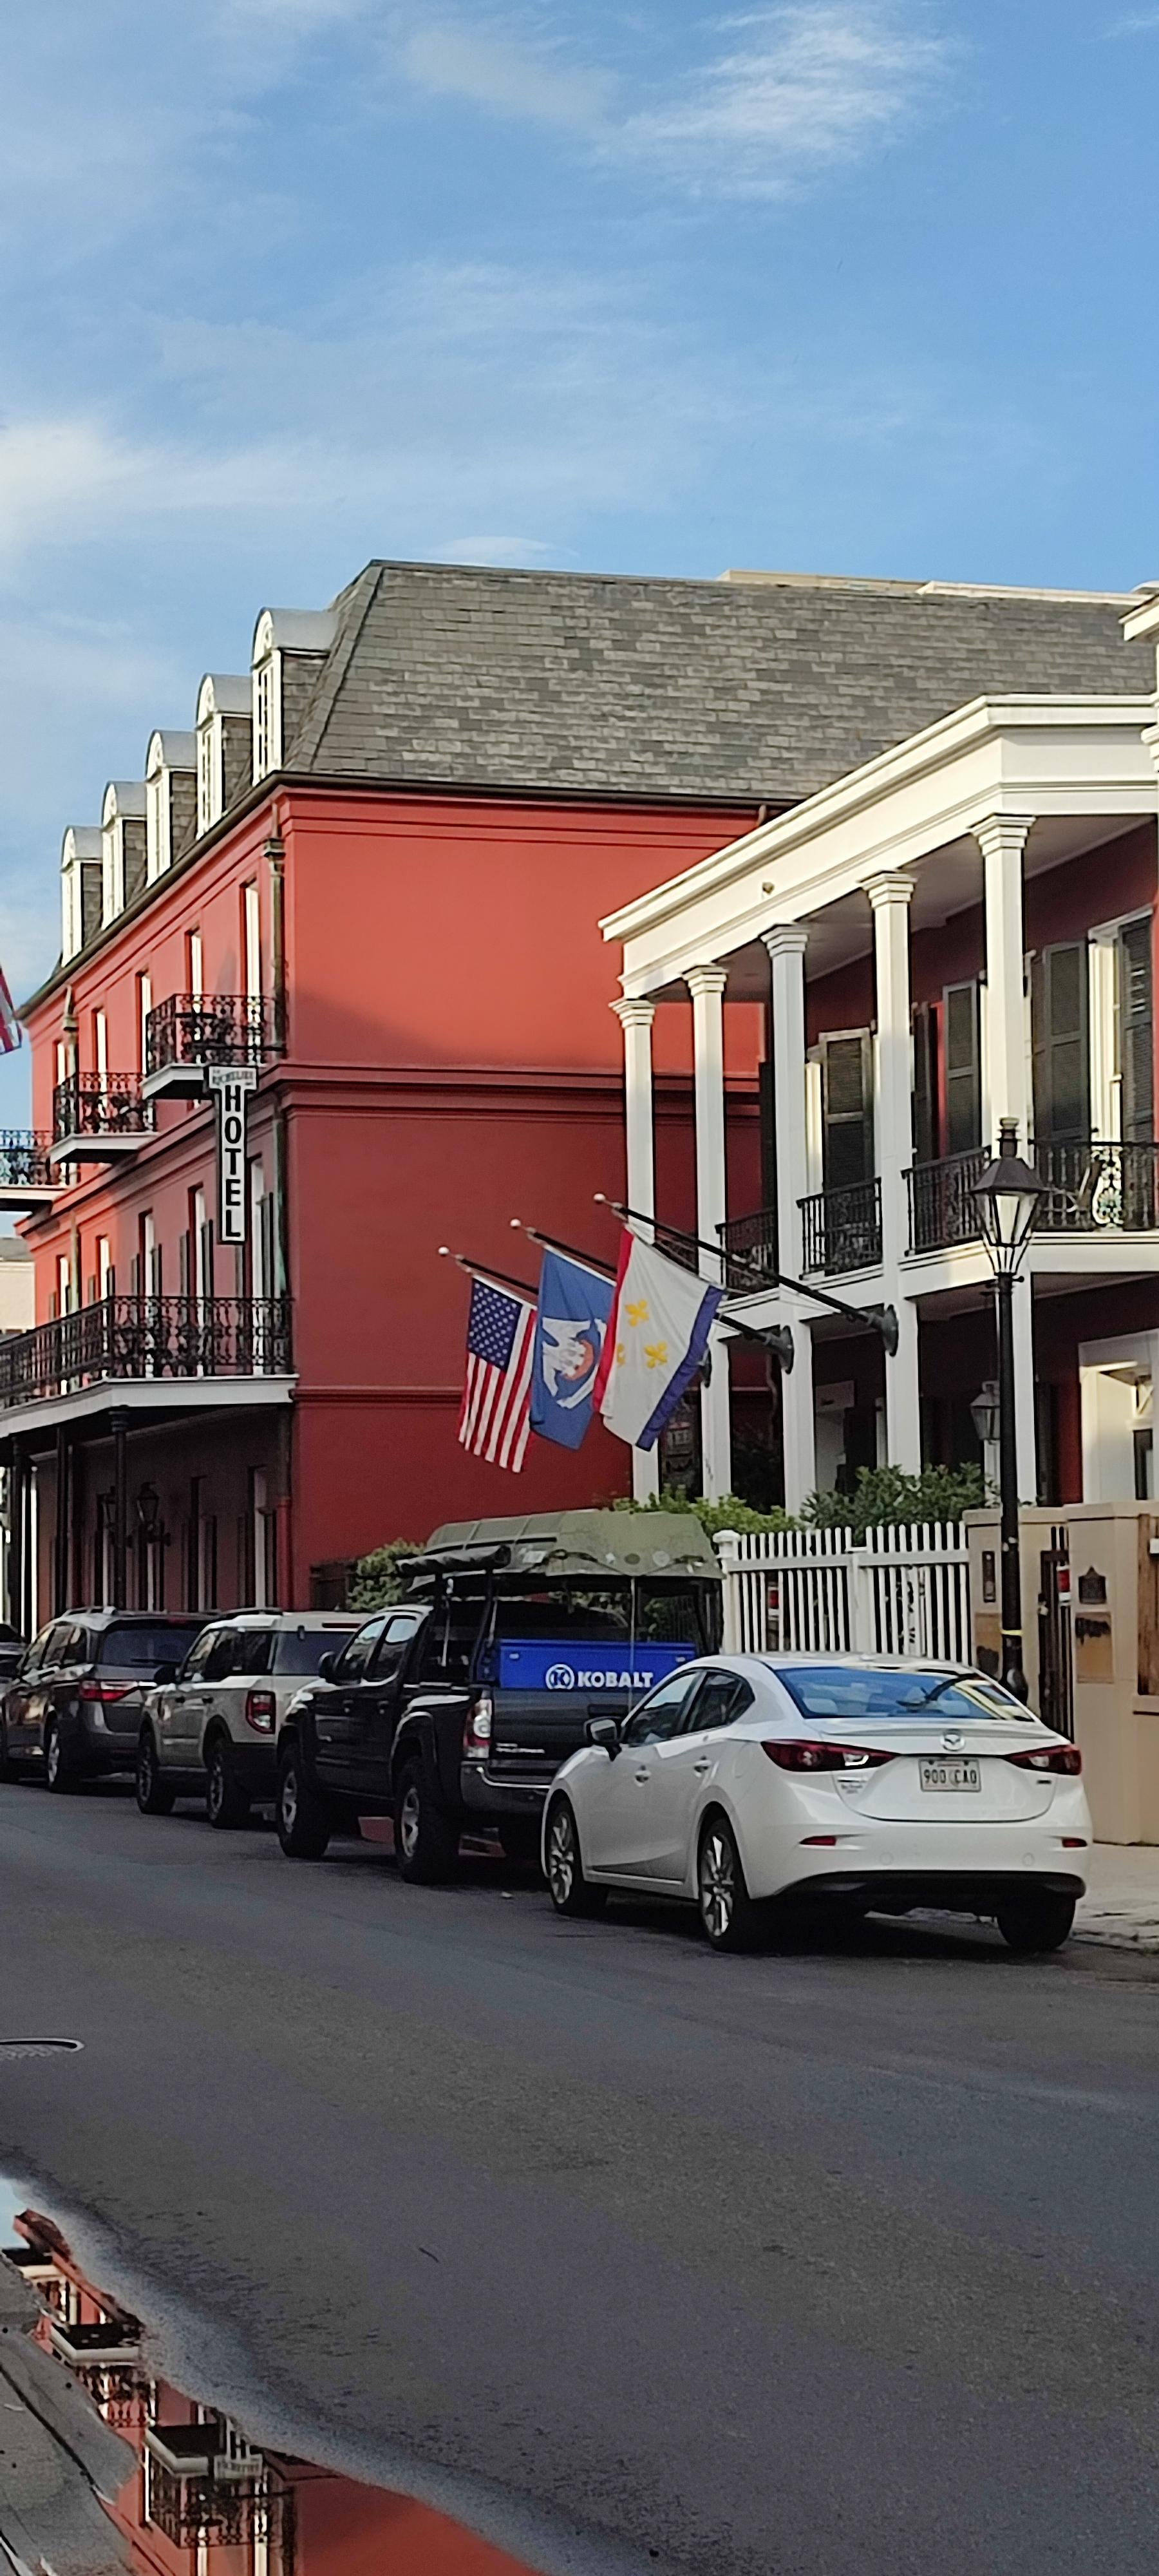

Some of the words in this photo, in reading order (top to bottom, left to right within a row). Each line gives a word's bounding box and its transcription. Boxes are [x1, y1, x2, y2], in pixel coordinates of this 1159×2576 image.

[225, 1084, 241, 1236] HOTEL
[578, 1671, 654, 1687] KOBALT
[924, 1769, 946, 1783] 900
